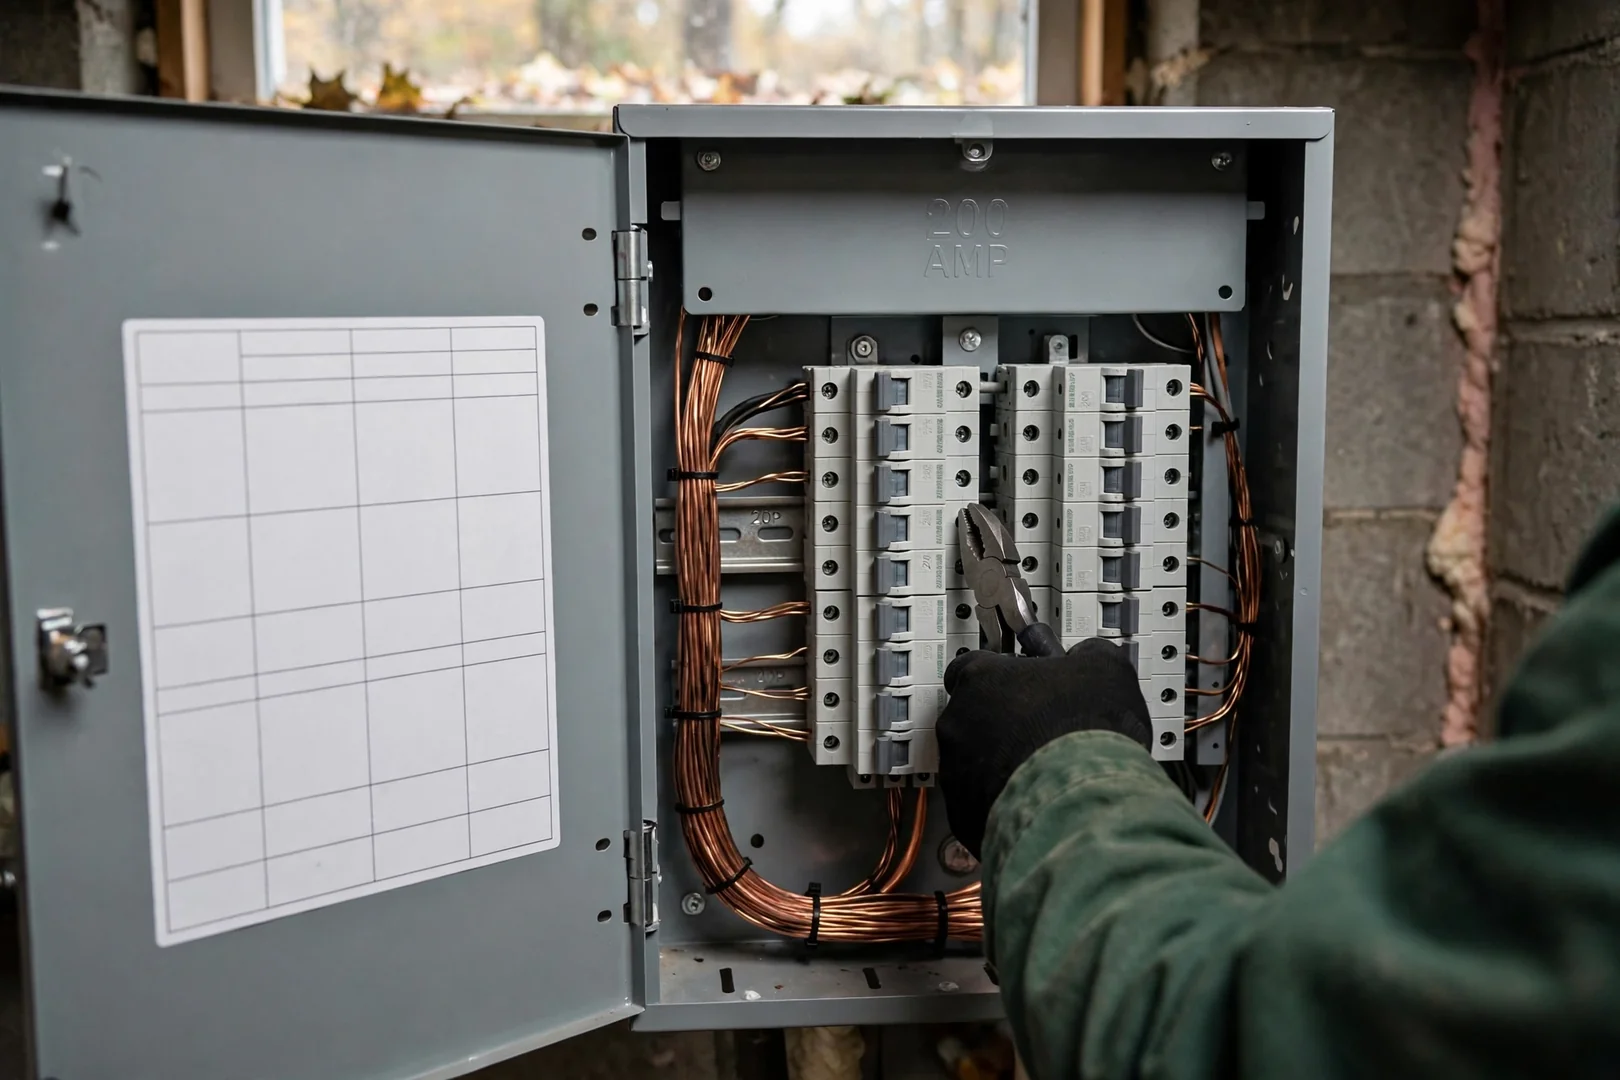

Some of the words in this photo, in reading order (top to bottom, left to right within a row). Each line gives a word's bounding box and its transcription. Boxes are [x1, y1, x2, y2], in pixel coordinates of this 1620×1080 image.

[925, 198, 1009, 241] 200
[923, 244, 1009, 279] AMP
[750, 509, 782, 526] 20P
